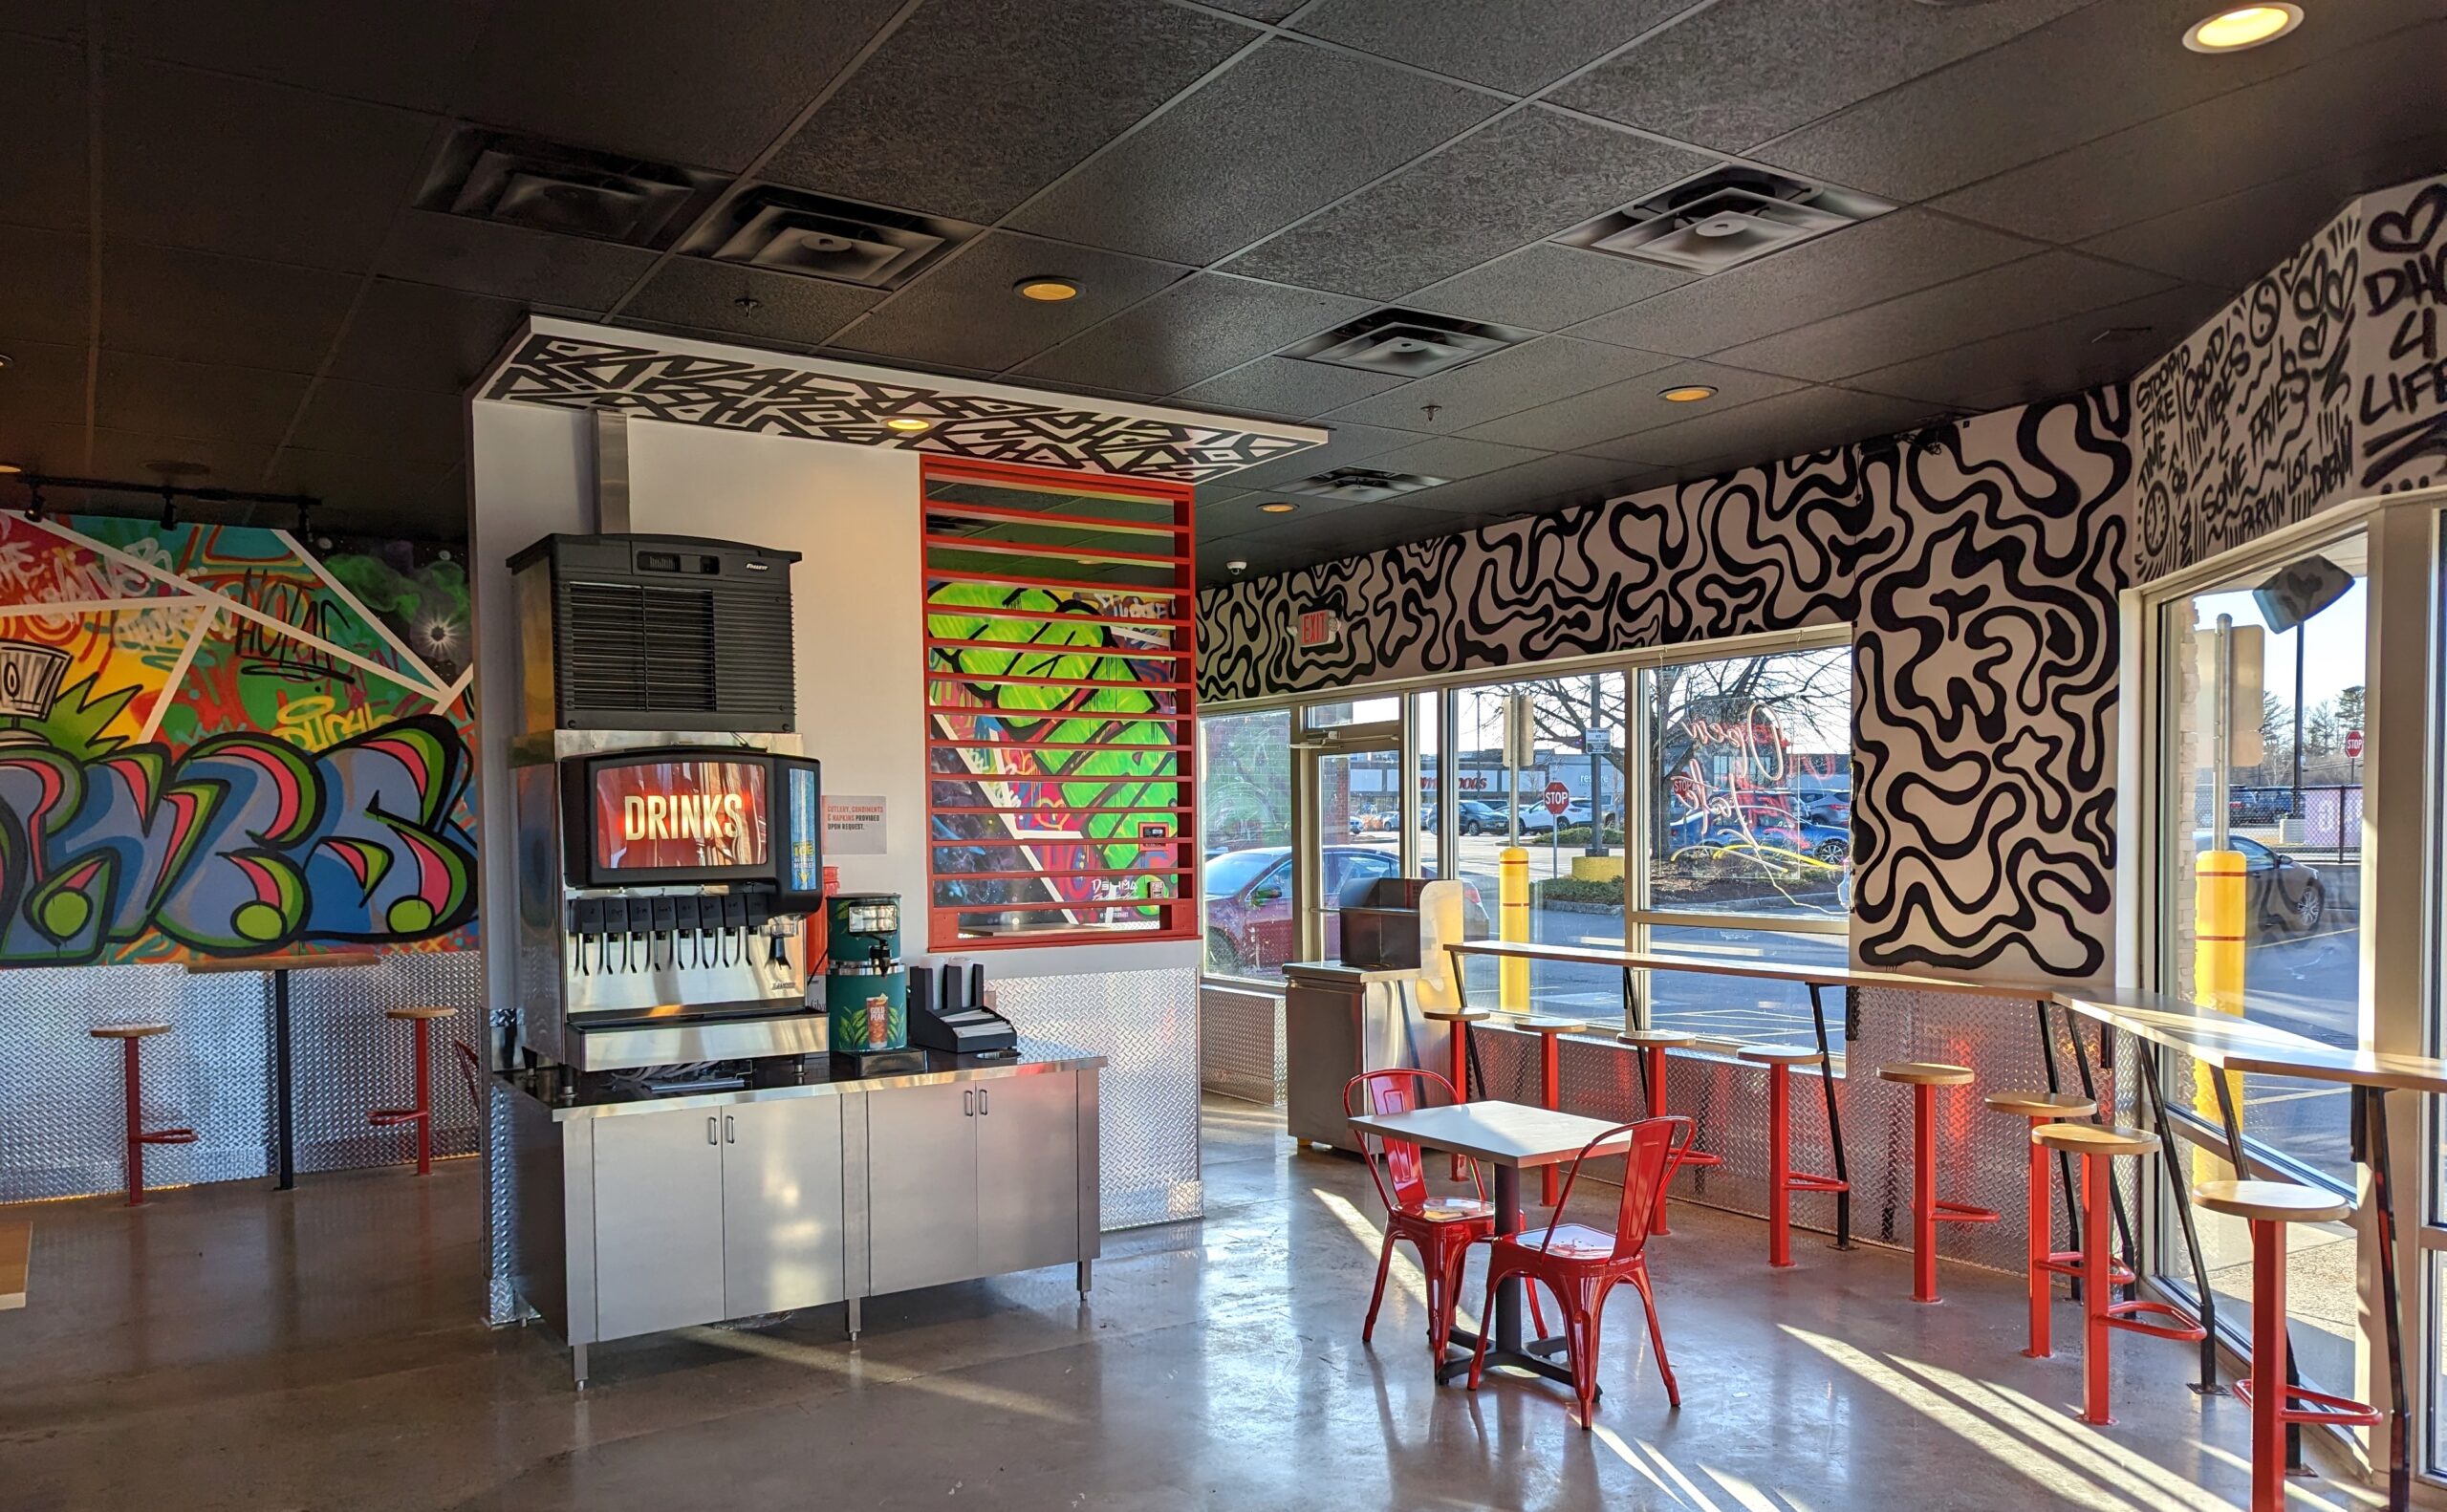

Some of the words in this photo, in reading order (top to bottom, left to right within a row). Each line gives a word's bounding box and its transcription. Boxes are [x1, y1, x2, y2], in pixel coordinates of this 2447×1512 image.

[2389, 306, 2437, 361] 4
[2136, 344, 2191, 413] STOOPID
[2182, 326, 2224, 422] GOOD
[2198, 332, 2251, 443] VIBES
[2141, 388, 2176, 449] FIRE
[2136, 430, 2167, 493] TIME
[2200, 442, 2248, 523] SOME
[2287, 438, 2313, 496] LOT
[1303, 612, 1326, 643] EXIT
[2347, 739, 2362, 749] STOP
[1545, 791, 1568, 805] STOP
[1674, 779, 1692, 792] STOP
[624, 793, 743, 841] DRINKS
[794, 844, 814, 856] ICE
